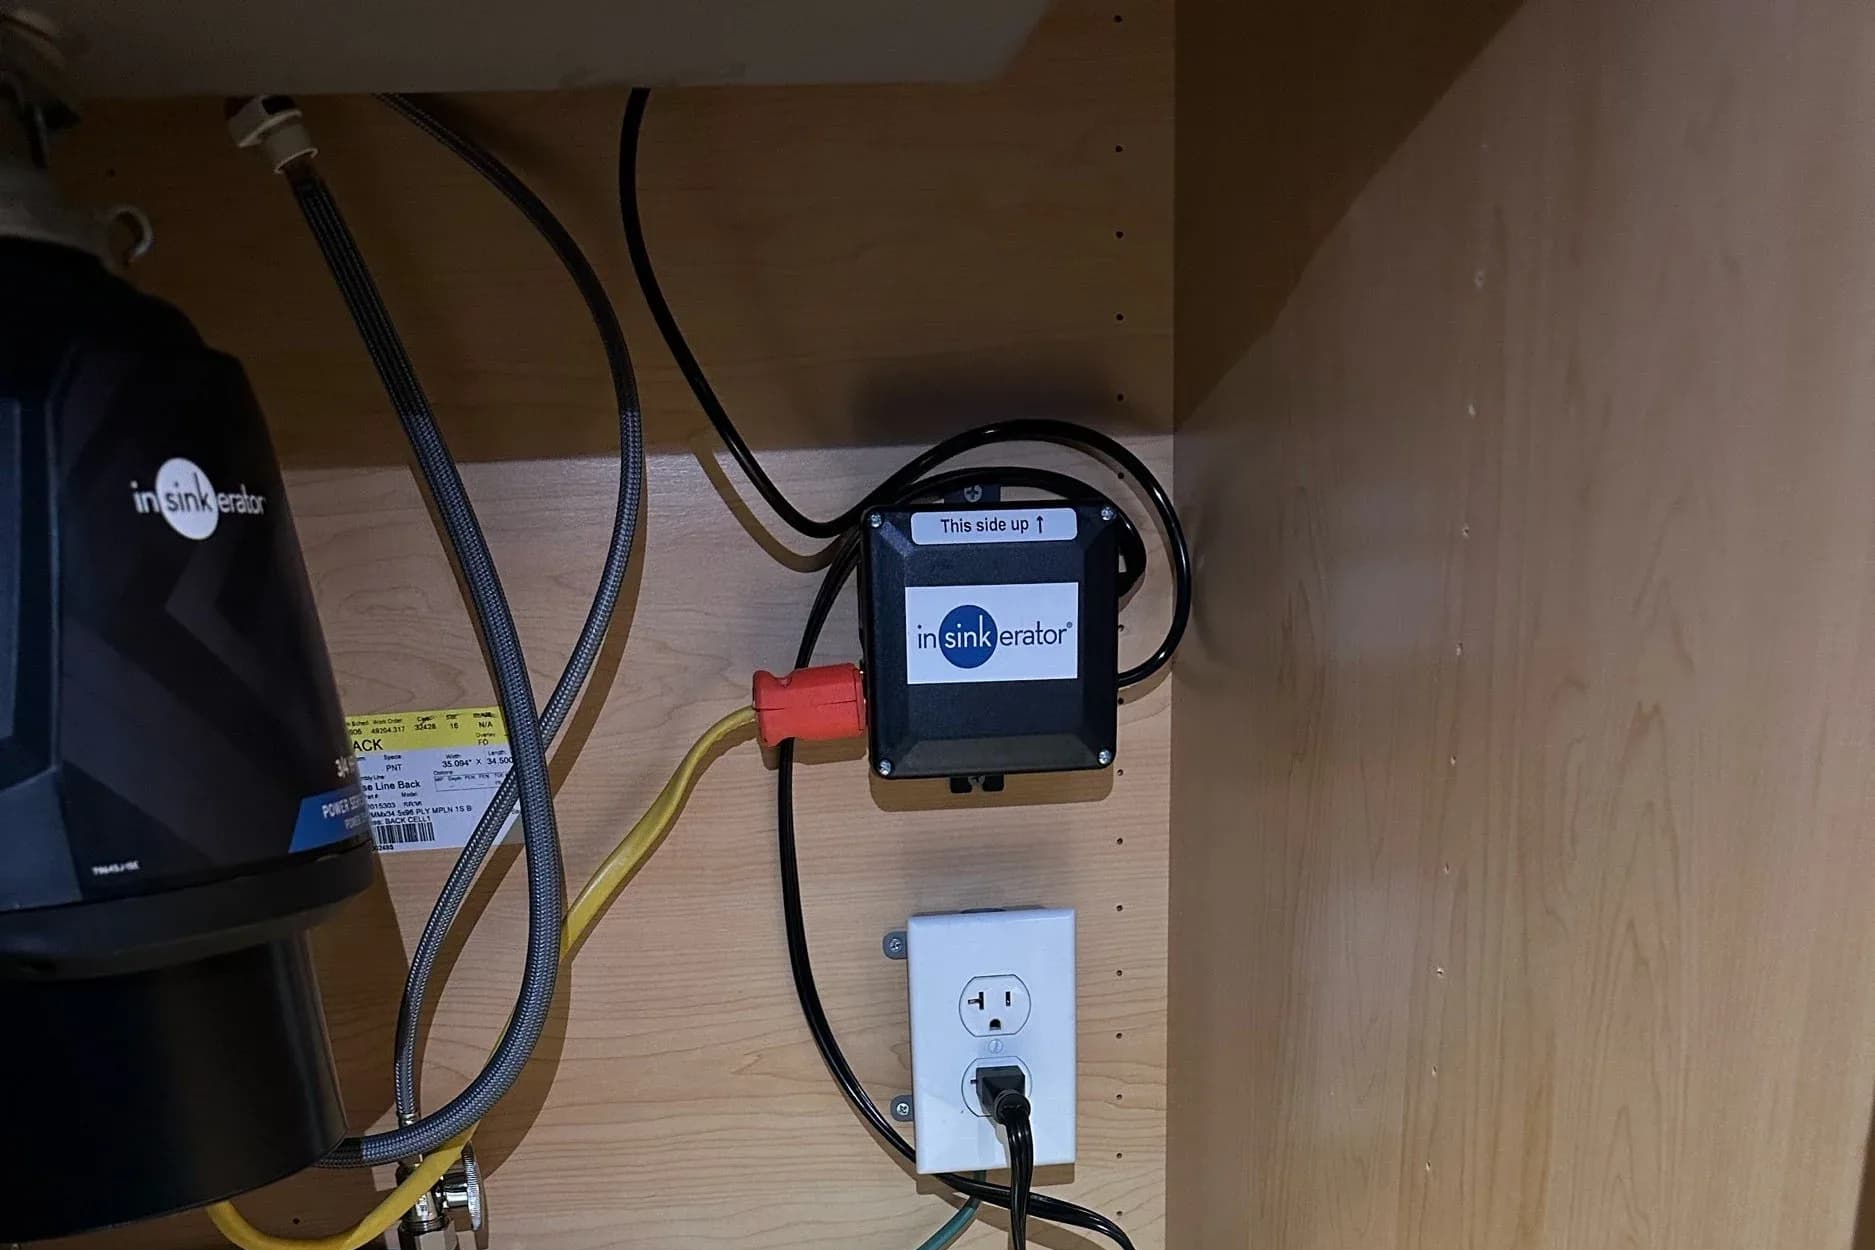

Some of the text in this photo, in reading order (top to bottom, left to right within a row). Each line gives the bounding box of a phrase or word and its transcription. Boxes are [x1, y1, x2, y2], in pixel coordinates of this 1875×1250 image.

[941, 518, 1029, 534] This side up
[353, 739, 384, 751] ACK
[386, 763, 402, 772] PNT
[375, 782, 395, 791] Line
[397, 780, 421, 789] Back
[322, 797, 350, 819] POWER
[416, 807, 430, 815] PLY
[385, 816, 406, 825] BACK
